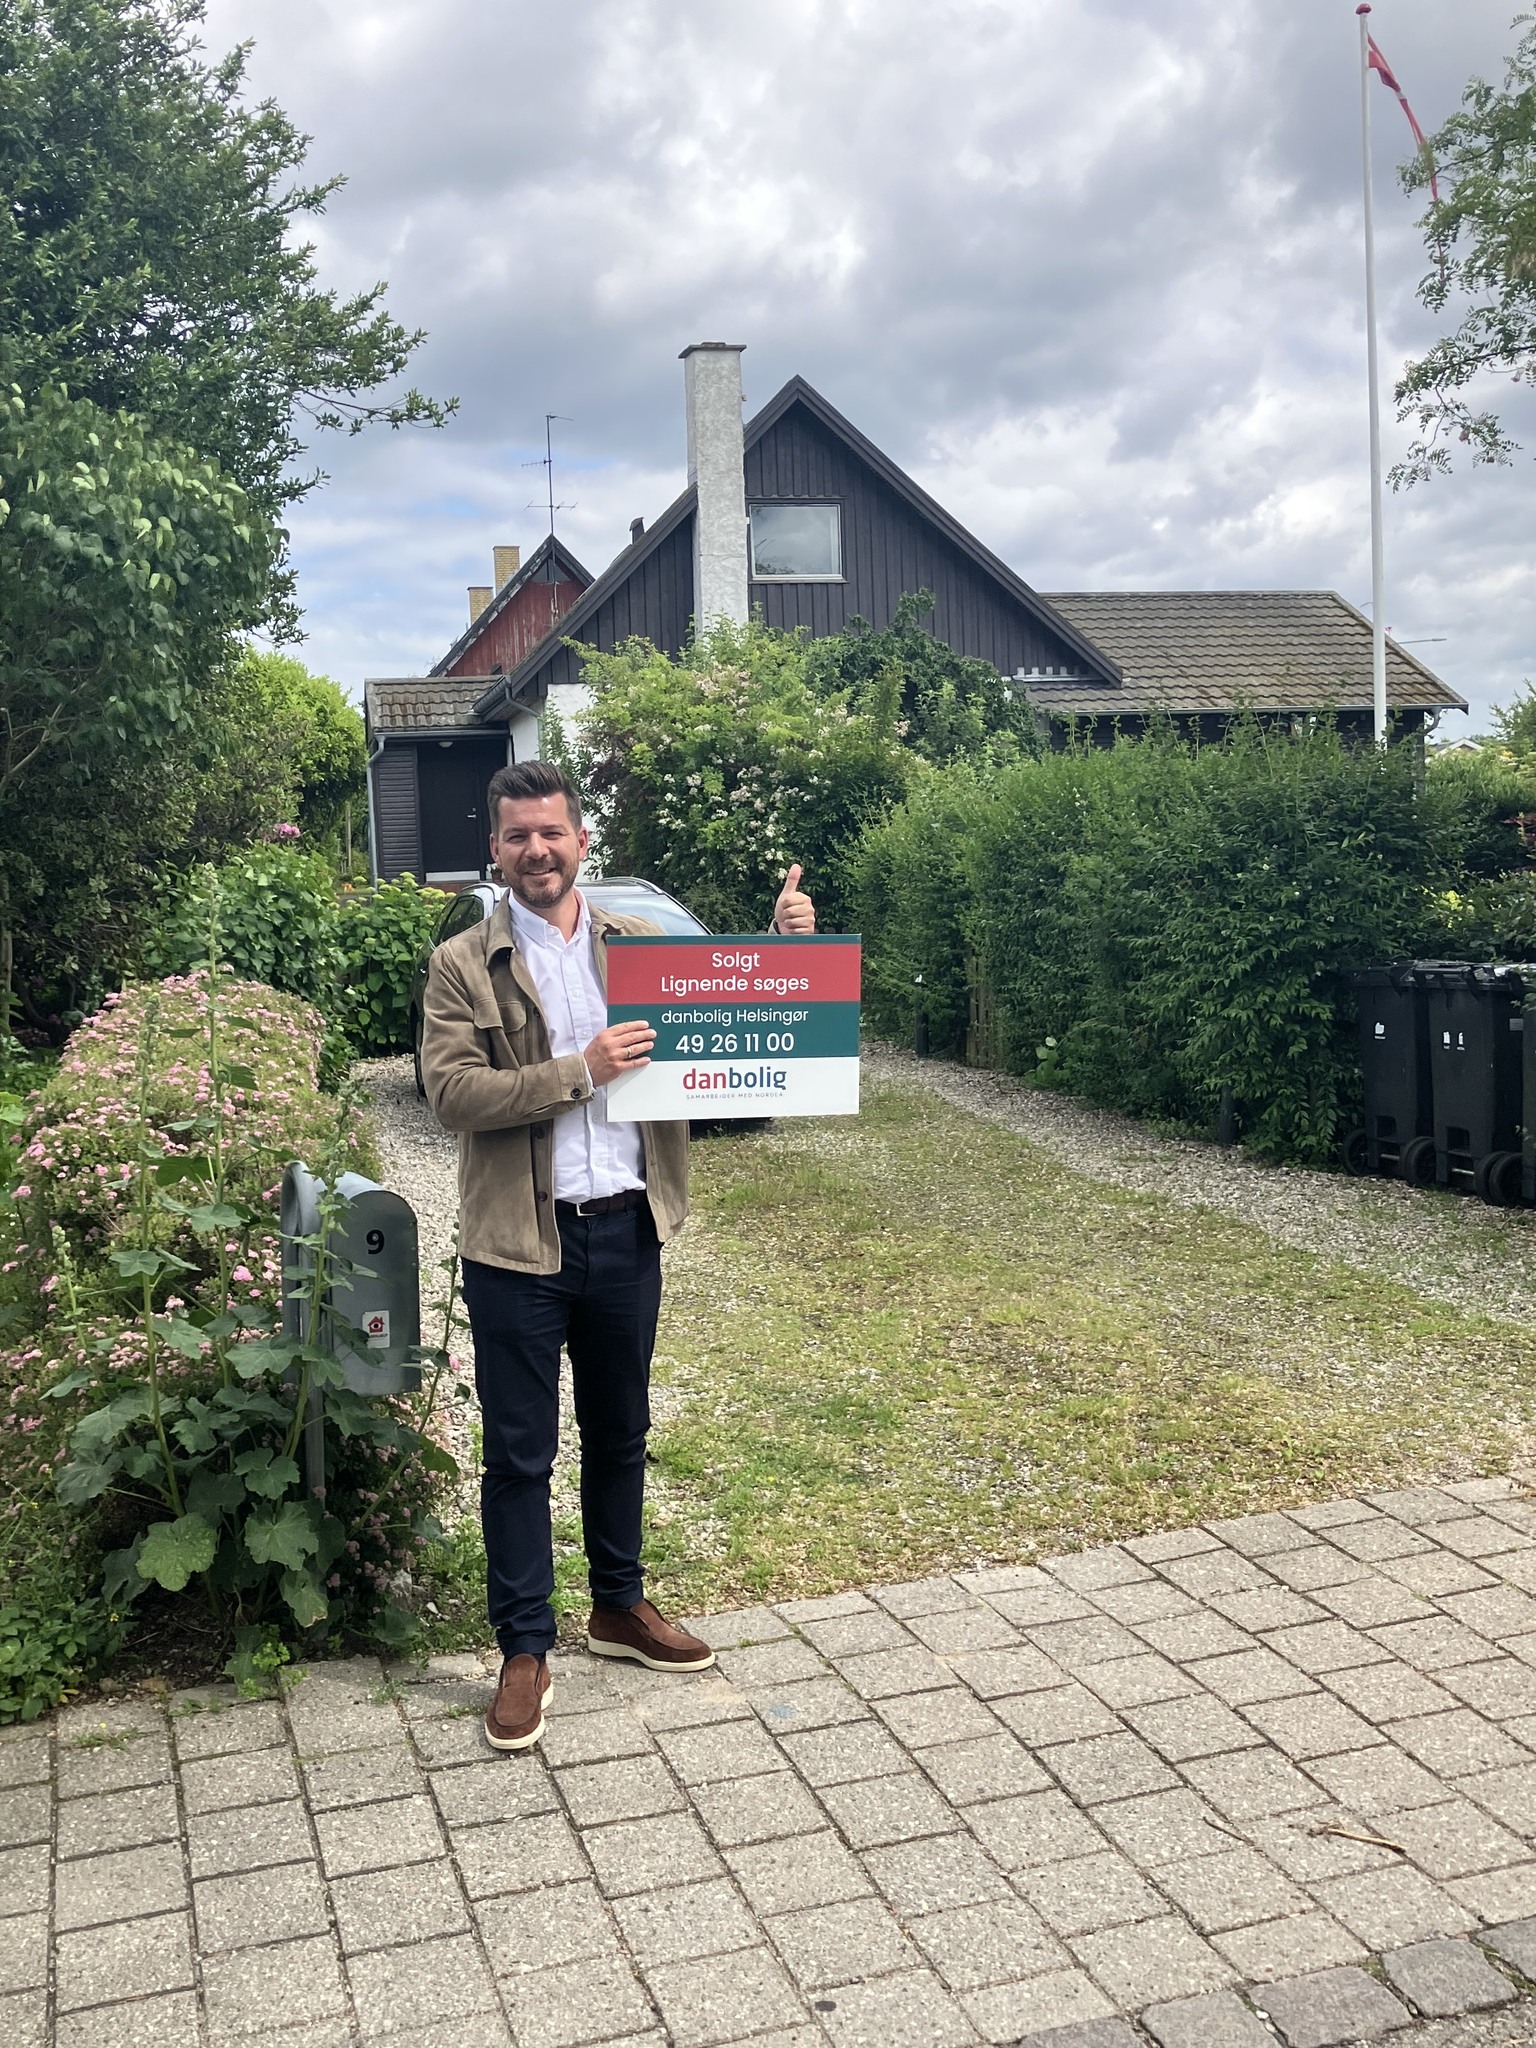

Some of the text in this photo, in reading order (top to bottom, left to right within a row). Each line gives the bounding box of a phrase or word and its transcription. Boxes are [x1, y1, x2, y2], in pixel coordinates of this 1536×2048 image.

[711, 952, 760, 972] Solgt
[661, 975, 809, 996] Lignende søges
[661, 1008, 809, 1027] danbolig Helsingør
[675, 1032, 795, 1053] 49 26 11 00
[682, 1066, 788, 1090] danbolig
[366, 1229, 385, 1254] 9
